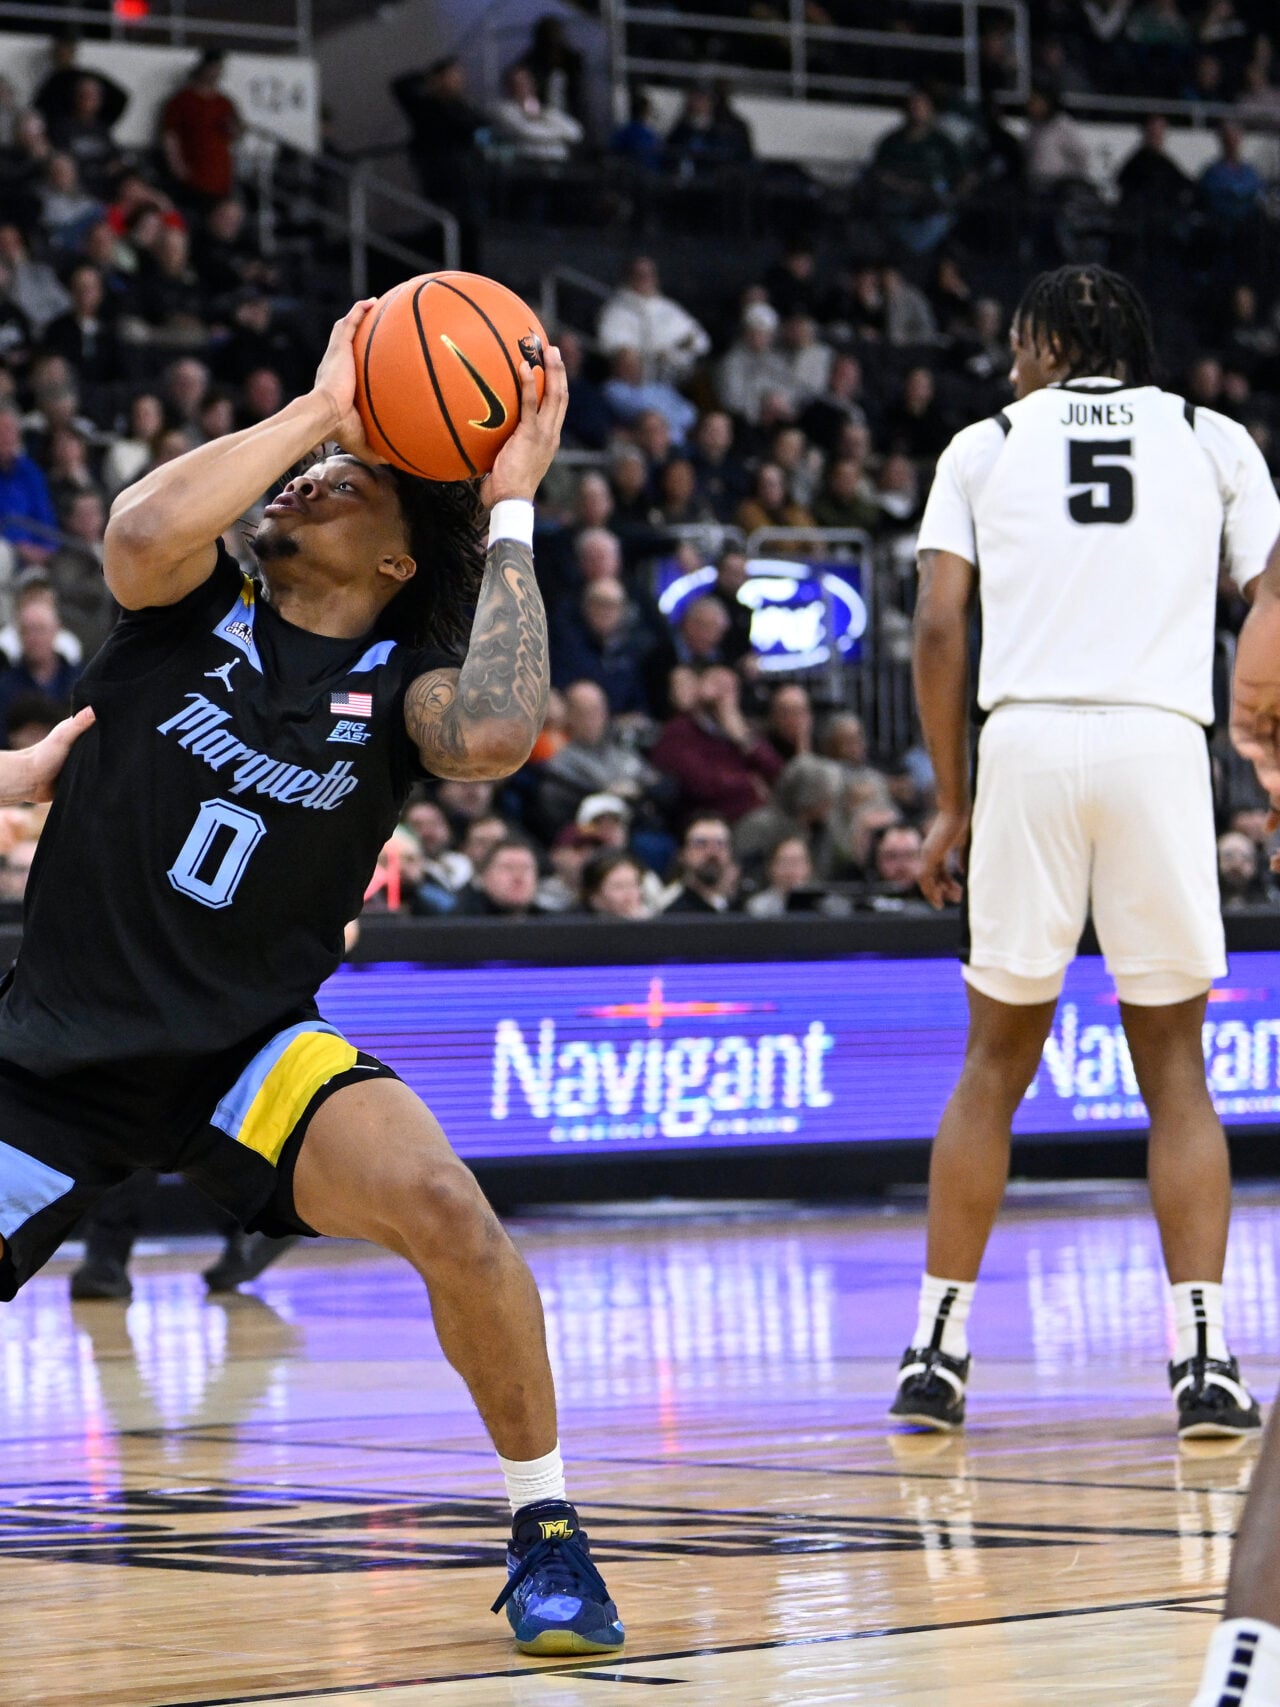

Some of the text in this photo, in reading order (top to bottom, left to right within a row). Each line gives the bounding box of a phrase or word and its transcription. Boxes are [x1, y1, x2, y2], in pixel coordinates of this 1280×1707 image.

[1061, 403, 1133, 425] JONES
[1066, 437, 1135, 526] 5
[156, 692, 359, 811] Marquette
[329, 728, 372, 741] EAST
[336, 720, 367, 732] BIG
[167, 797, 268, 910] 0
[490, 1019, 835, 1137] Navigant
